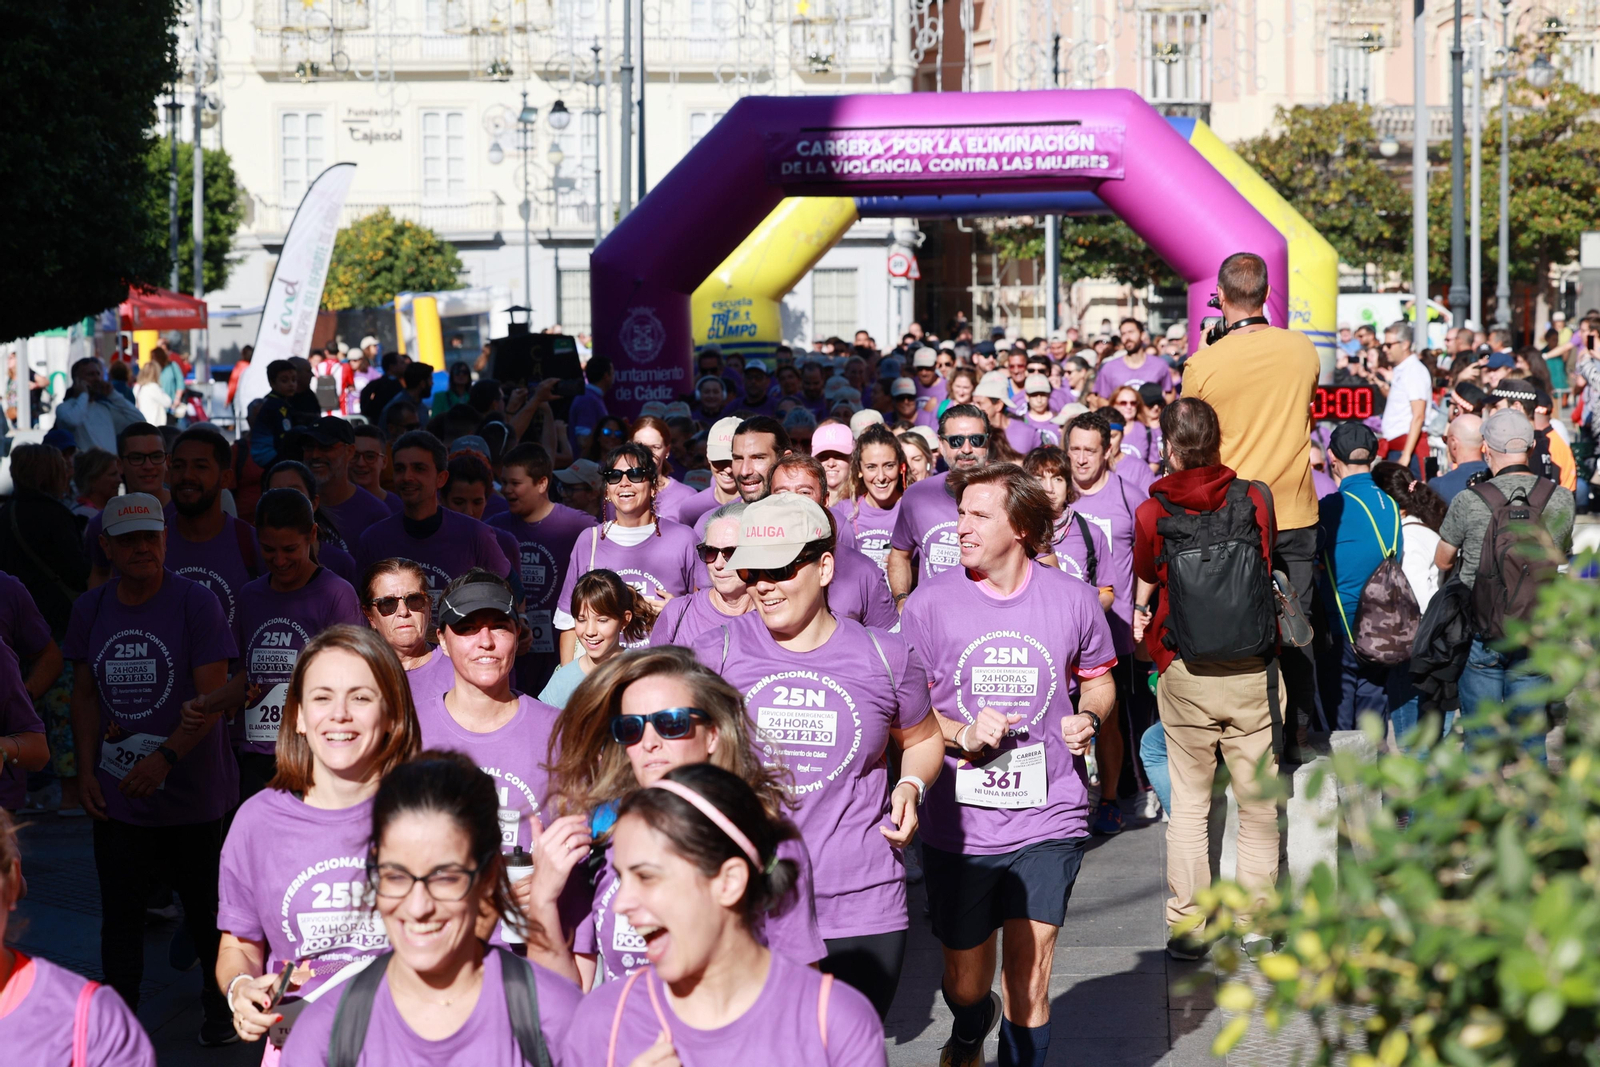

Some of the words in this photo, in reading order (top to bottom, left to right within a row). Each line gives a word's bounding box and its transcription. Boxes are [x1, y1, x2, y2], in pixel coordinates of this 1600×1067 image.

[796, 138, 884, 156] CARRERA
[892, 137, 934, 155] POR
[938, 137, 963, 154] LA
[966, 130, 1095, 153] ELIMINACIÓN
[781, 161, 802, 175] DE
[806, 161, 827, 174] LA
[831, 158, 924, 174] VIOLENCIA
[928, 156, 999, 173] CONTRA
[1002, 155, 1034, 171] LAS
[1035, 154, 1110, 170] MUJERES
[613, 366, 685, 383] yuntamiento
[615, 386, 631, 401] de
[634, 384, 674, 401] Cádiz
[118, 505, 150, 517] LALIGA
[746, 525, 785, 538] LALIGA
[939, 531, 959, 545] 25
[208, 570, 232, 595] CONTRA
[260, 631, 293, 647] 25N
[291, 621, 311, 646] CONTR
[114, 642, 149, 658] 25N
[145, 632, 170, 657] CONTRA
[957, 630, 1022, 669] INTERNACIONAL
[1023, 634, 1054, 666] CONTRA
[166, 657, 174, 668] LA
[265, 655, 288, 663] HORAS
[983, 647, 1028, 665] 25N
[122, 665, 148, 673] HORAS
[1049, 666, 1057, 680] LA
[953, 669, 962, 686] DÍA
[981, 674, 993, 683] 24
[994, 674, 1027, 683] HORAS
[154, 669, 175, 709] VIOLENCIA
[743, 670, 820, 707] NTERNACIONAL
[772, 685, 826, 708] 25N
[821, 676, 856, 712] CONTRA
[974, 684, 995, 692] 900
[997, 684, 1006, 692] 21
[1008, 684, 1018, 693] 21
[1020, 685, 1033, 693] 30
[1030, 681, 1058, 726] VIOLENCIA
[129, 708, 153, 720] HACIA
[259, 705, 284, 723] 28
[761, 709, 787, 718] SERVICIO
[794, 711, 835, 720] EMERGENCIAS
[852, 711, 862, 727] LA
[768, 717, 781, 727] 24
[783, 718, 824, 730] HORAS
[786, 730, 798, 740] 21
[800, 731, 812, 741] 21
[815, 732, 831, 742] 30
[826, 728, 863, 782] VIOLENCIA
[1016, 749, 1042, 760] CARRERA
[982, 769, 1022, 789] 361
[504, 772, 539, 811] CONTRA
[1001, 790, 1029, 798] MENOS
[311, 881, 377, 909] 25N
[311, 925, 326, 937] 24
[329, 922, 376, 935] HORAS
[334, 936, 348, 946] 21
[350, 932, 364, 946] 21
[365, 935, 384, 948] 30
[617, 934, 647, 948] 900
